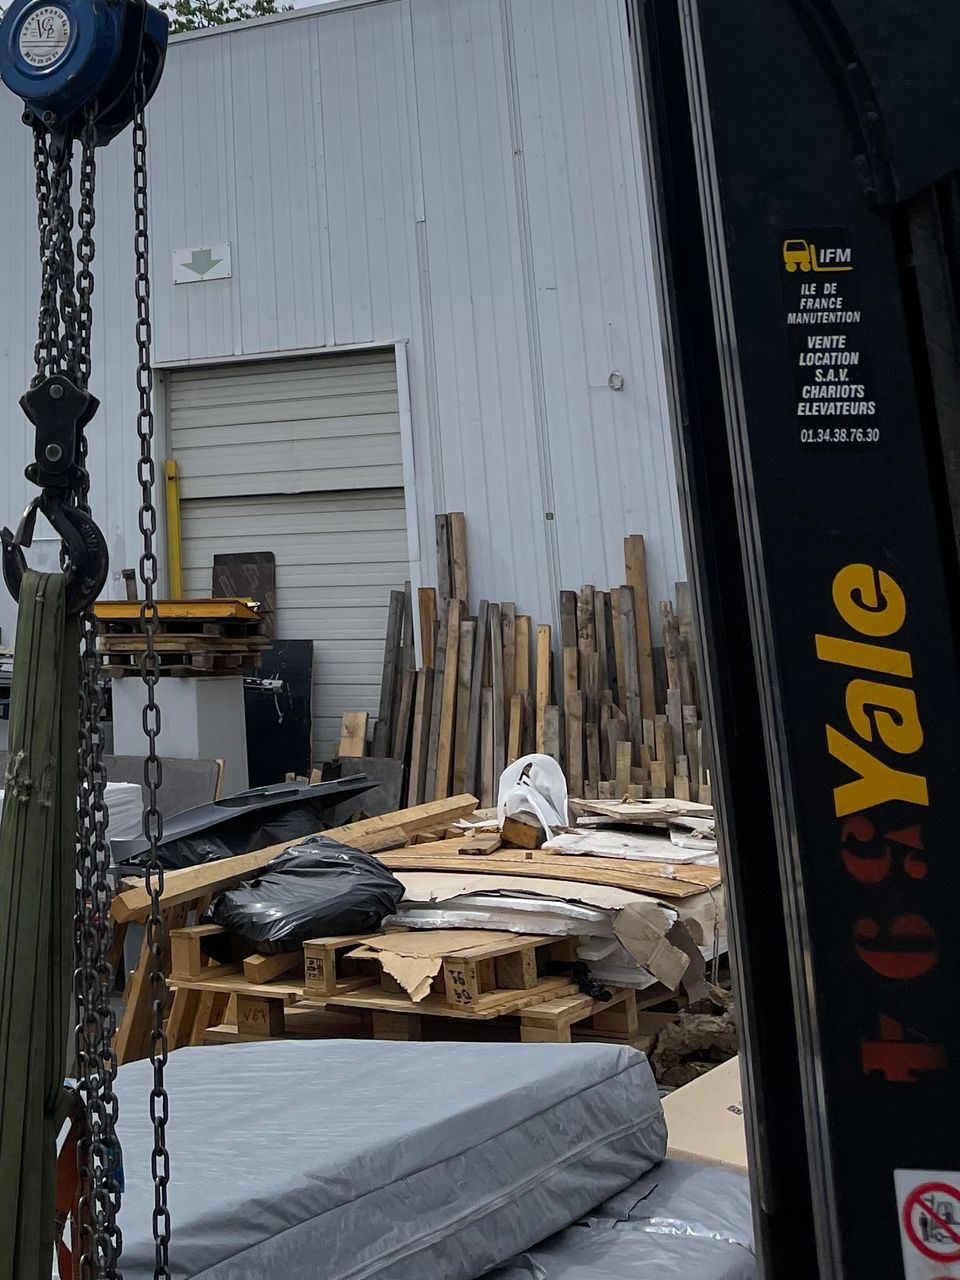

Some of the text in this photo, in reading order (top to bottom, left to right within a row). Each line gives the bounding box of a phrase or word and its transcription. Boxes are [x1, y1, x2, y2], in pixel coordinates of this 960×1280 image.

[820, 248, 851, 263] IFM
[800, 283, 837, 295] ILE DE
[799, 297, 843, 310] FRANCE
[787, 311, 861, 324] MANUTENTION
[807, 335, 847, 349] VENTE
[799, 351, 860, 366] LOCATION
[815, 368, 850, 382] S.A.V.
[802, 384, 865, 399] CHARIOTS
[797, 401, 876, 416] ELEVATEURS
[800, 428, 880, 443] 01.34.38.76.30
[815, 562, 930, 818] Yale
